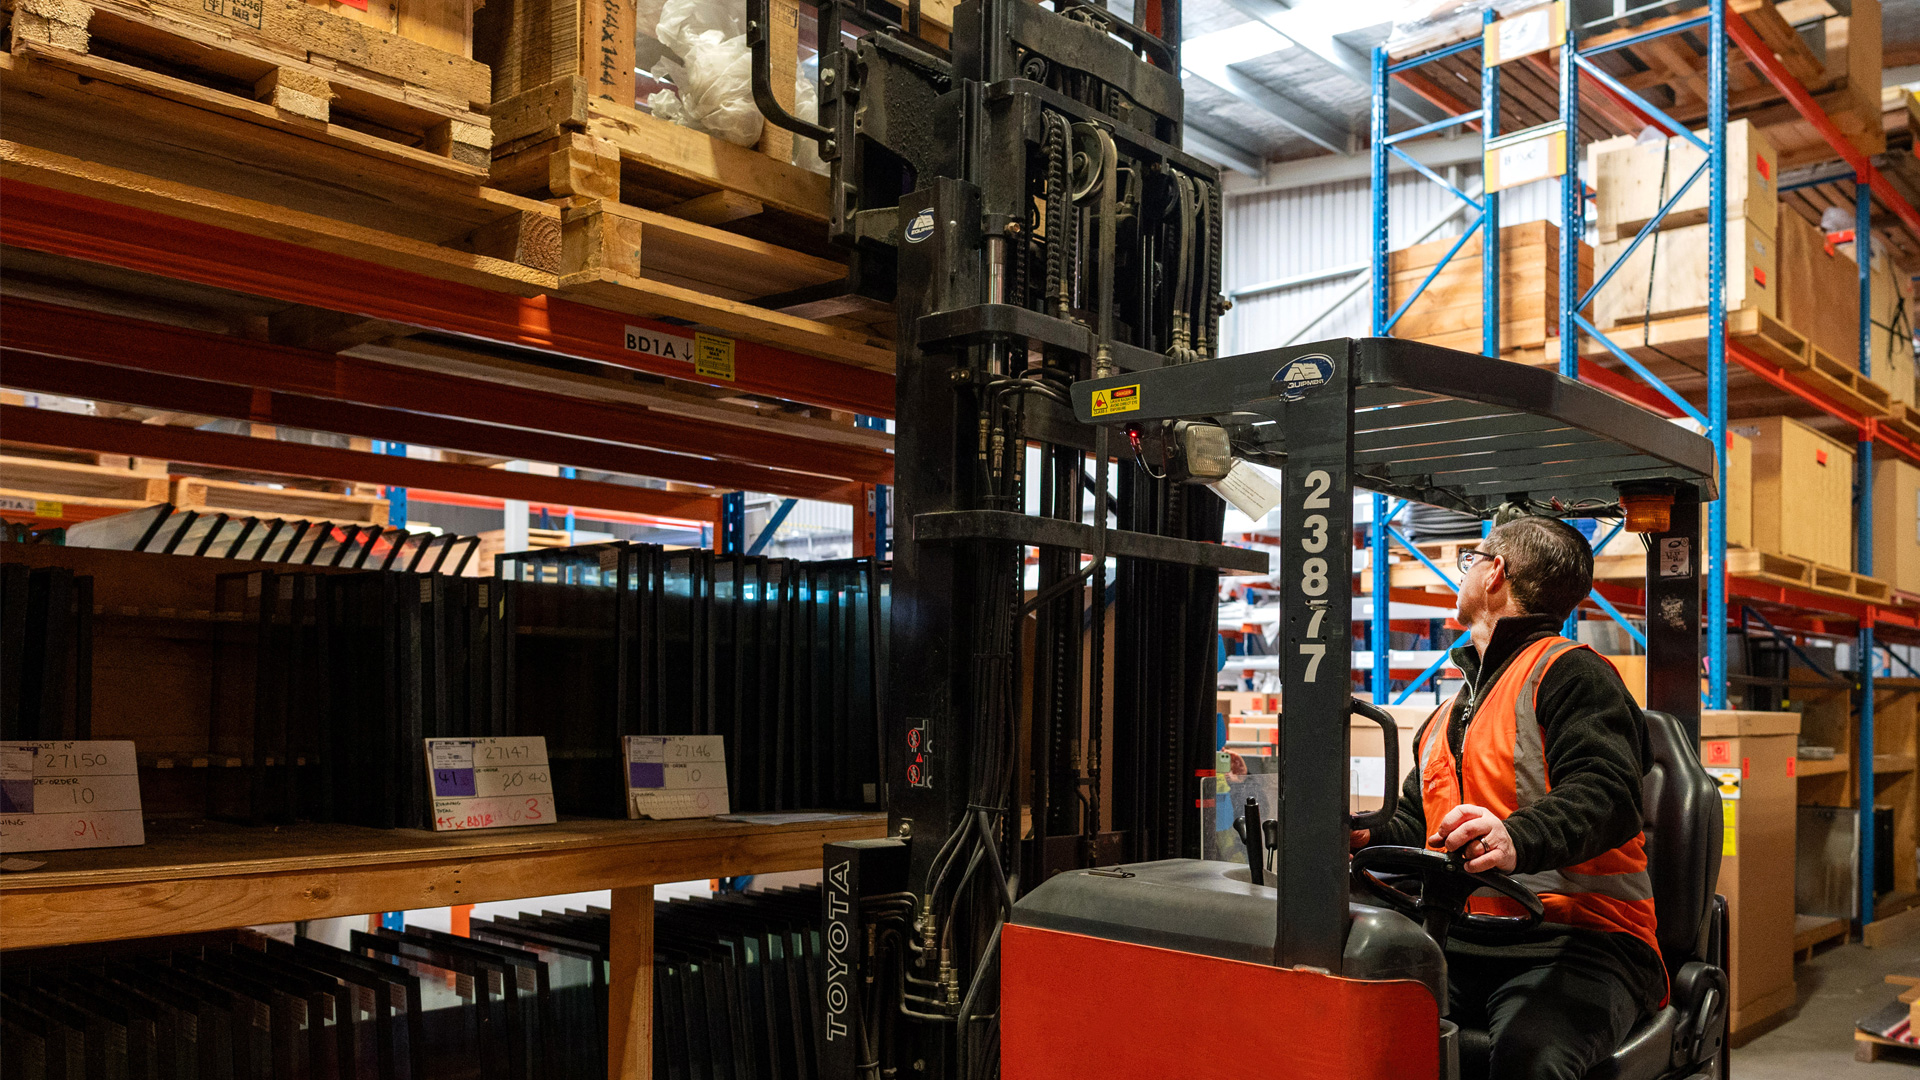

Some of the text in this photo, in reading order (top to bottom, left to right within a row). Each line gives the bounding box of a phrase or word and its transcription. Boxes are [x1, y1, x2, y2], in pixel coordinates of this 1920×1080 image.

[626, 333, 676, 358] BD1A
[1288, 379, 1324, 389] QUIPMENT
[1300, 470, 1331, 682] 23877
[484, 746, 529, 759] 27147
[676, 744, 710, 757] 27146
[44, 754, 107, 768] 27150
[438, 771, 457, 786] 41
[528, 772, 548, 784] 40
[686, 769, 702, 782] 10
[73, 788, 94, 804] 10
[827, 860, 850, 1042] TOYOTA
